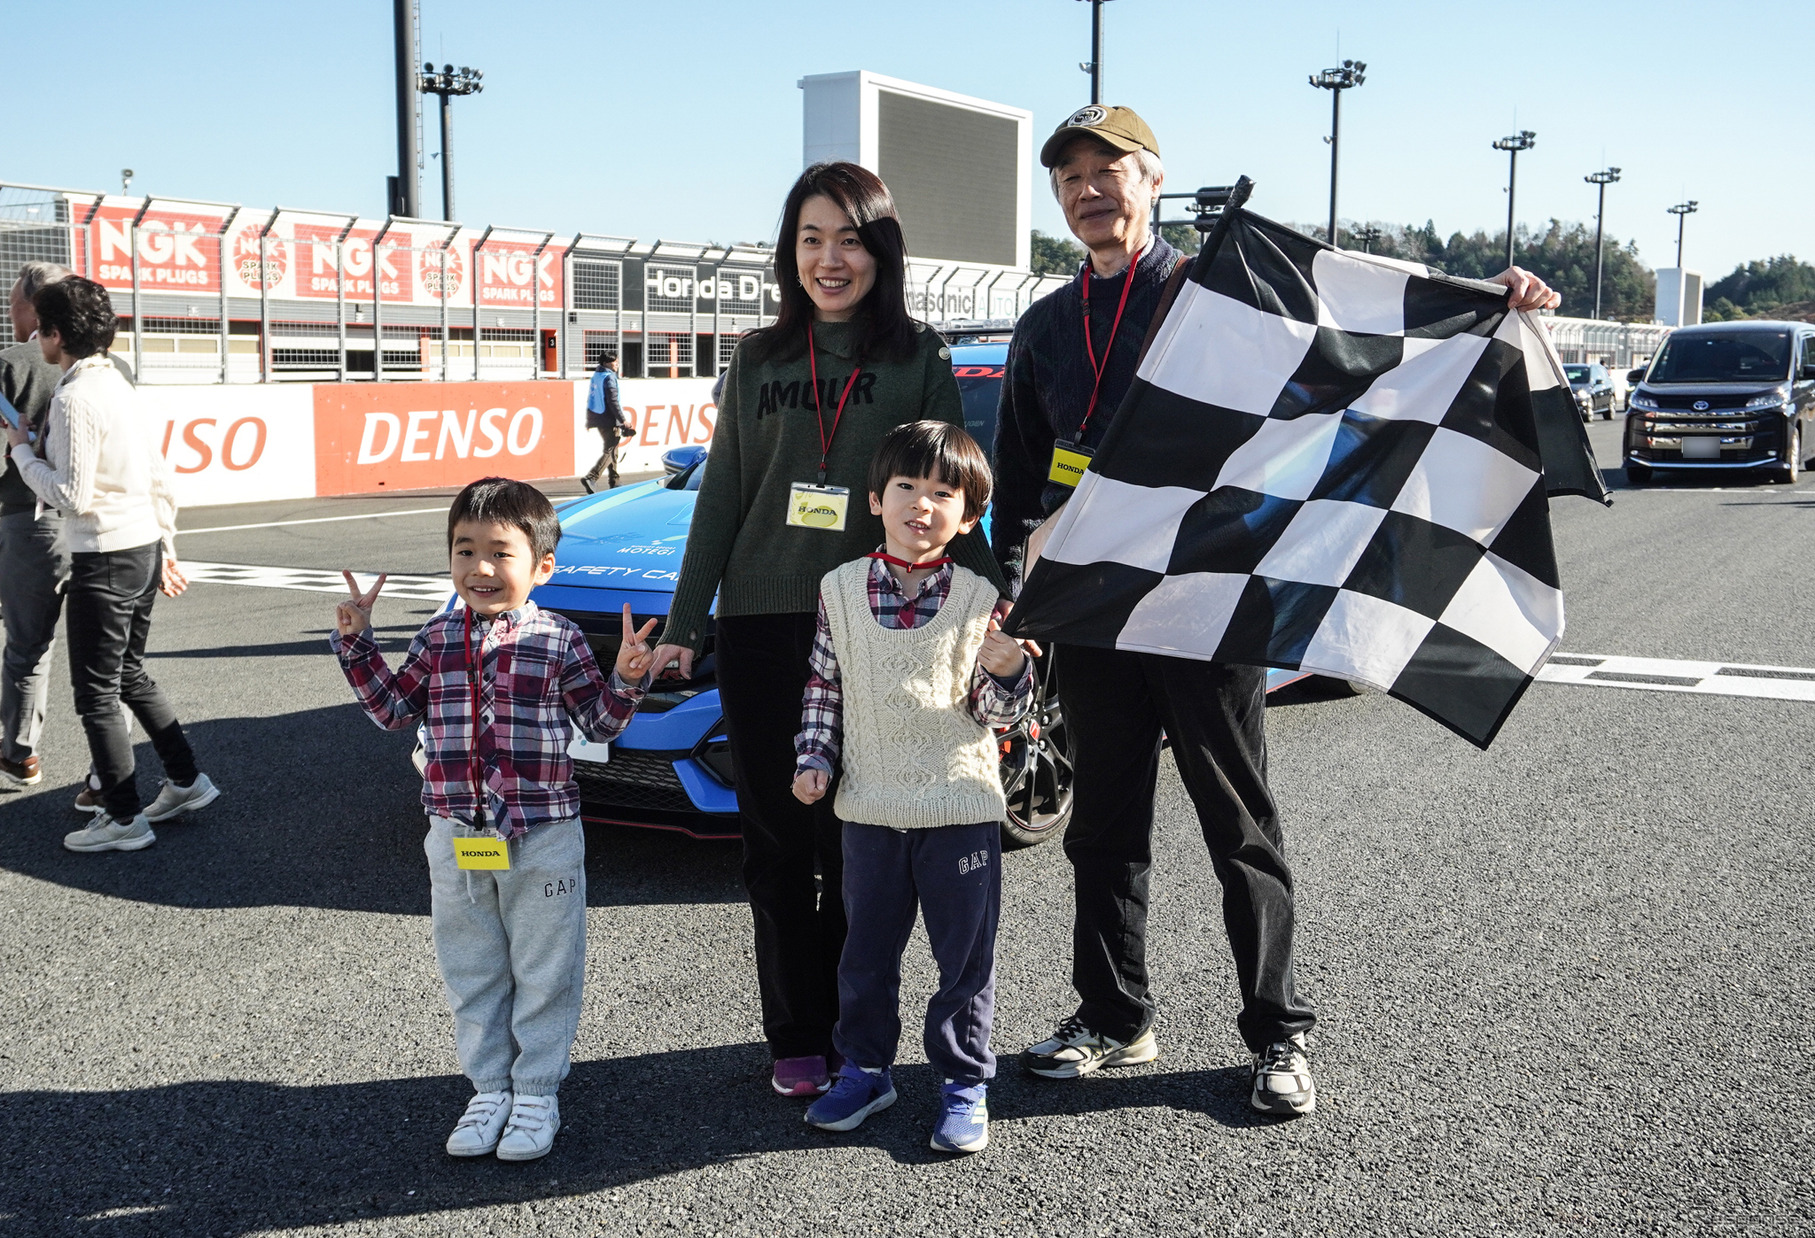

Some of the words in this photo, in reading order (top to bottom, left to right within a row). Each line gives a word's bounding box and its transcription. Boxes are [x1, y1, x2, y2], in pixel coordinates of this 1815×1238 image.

[100, 217, 207, 268] NGK
[312, 233, 399, 280] NGK
[155, 268, 208, 285] PLUGS
[483, 248, 554, 288] NGK
[311, 276, 355, 293] SPAK
[356, 279, 399, 295] PLGS
[646, 270, 734, 299] Honda
[482, 287, 518, 300] SPARK
[520, 289, 554, 302] PLGS
[550, 338, 556, 347] 3
[757, 372, 877, 420] AMOUR
[356, 406, 544, 465] DENSO
[1057, 462, 1085, 475] HONDA
[798, 505, 837, 516] HONDA
[617, 547, 676, 556] MOTEGI
[553, 565, 642, 577] SAFETY
[641, 569, 680, 581] CA
[958, 850, 989, 875] GAP
[544, 879, 576, 898] GAP
